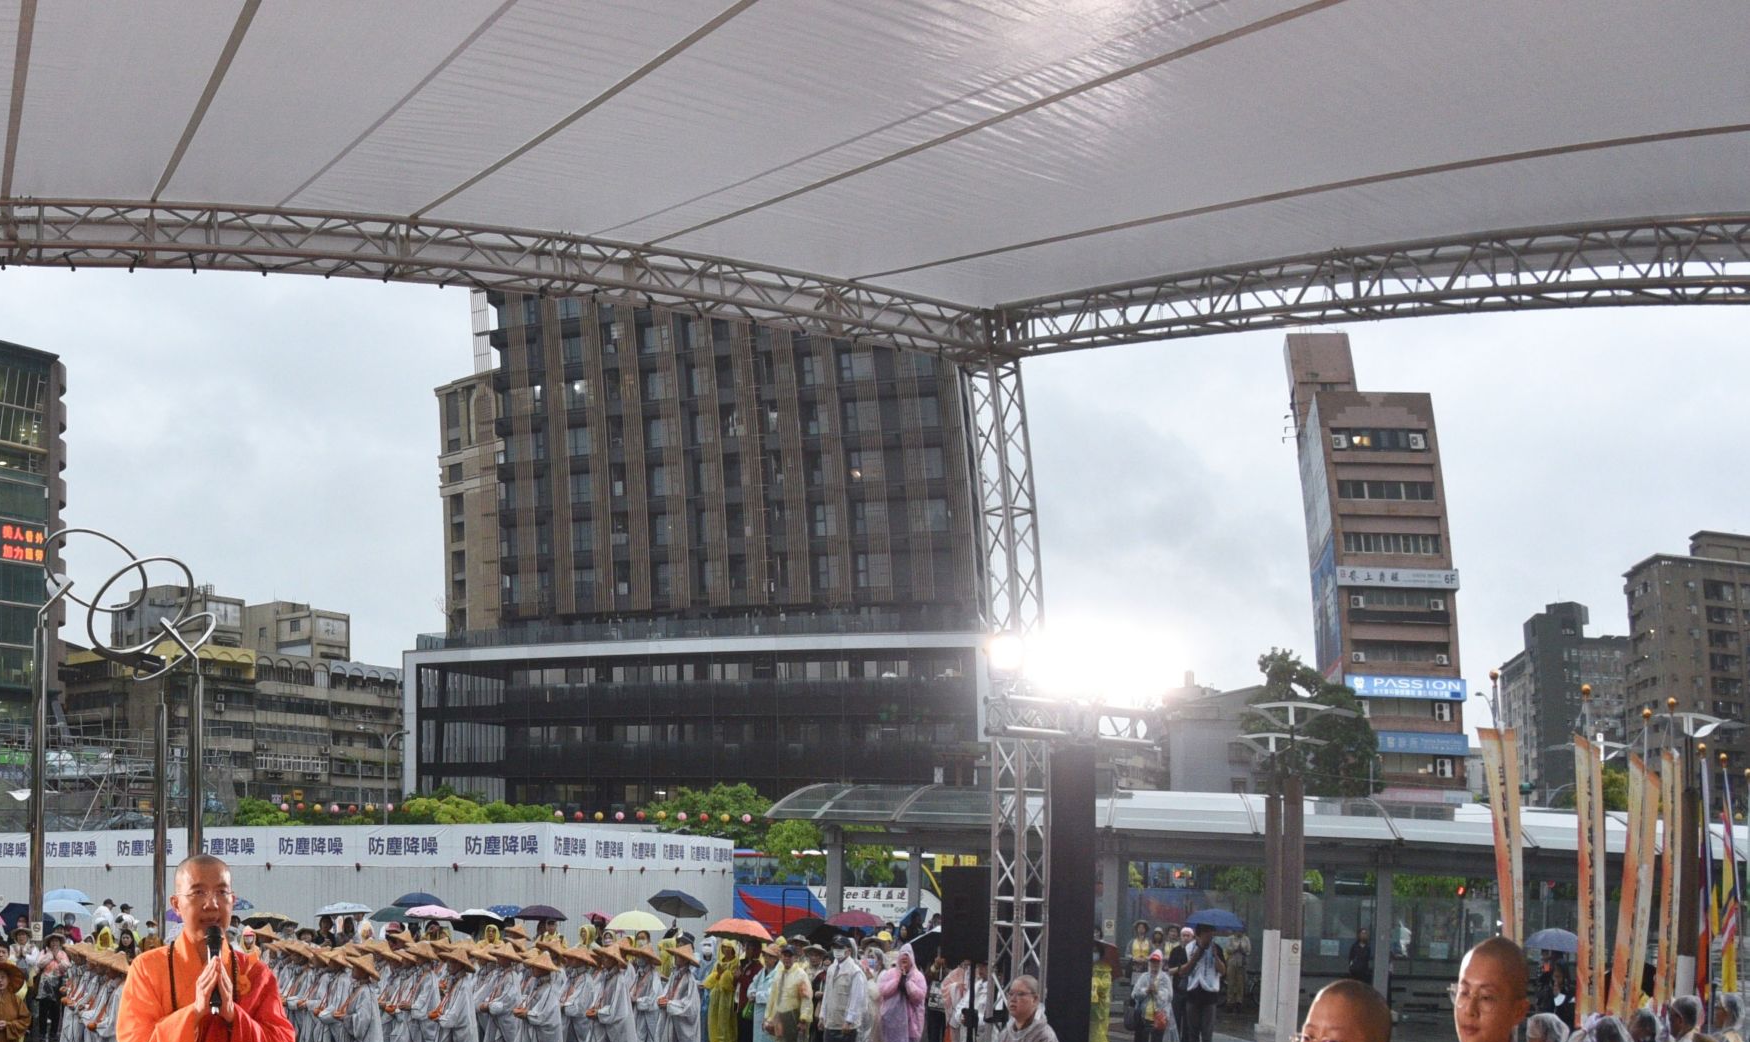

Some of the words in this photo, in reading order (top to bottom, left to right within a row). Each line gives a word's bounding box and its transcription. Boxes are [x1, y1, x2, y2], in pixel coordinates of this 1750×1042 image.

[1444, 574, 1456, 585] 6F
[1373, 678, 1461, 691] PASSION
[45, 841, 97, 858] 防塵降噪
[278, 836, 344, 856] 防塵降噪
[368, 835, 439, 856] 防塵降噪
[464, 835, 539, 856] 防塵降噪
[554, 835, 587, 857] 防塵降噪
[595, 839, 624, 859] 防塵降噪
[631, 842, 656, 860] 防塵降噪
[663, 843, 684, 861] 防塵降噪
